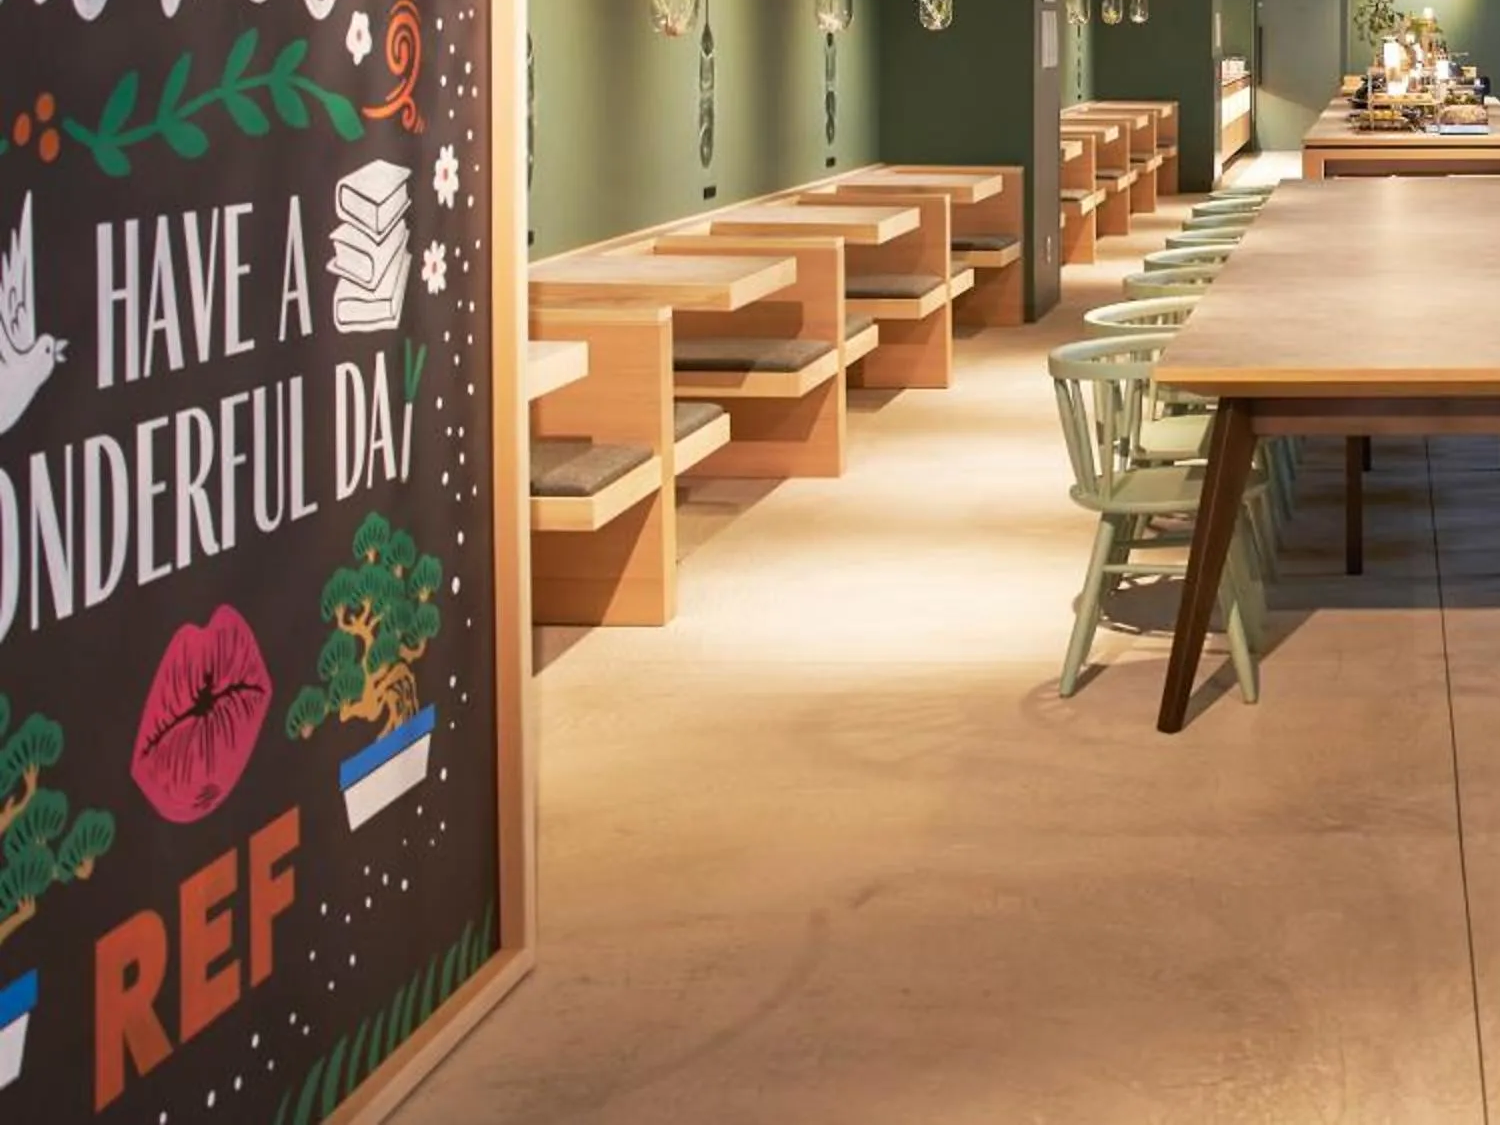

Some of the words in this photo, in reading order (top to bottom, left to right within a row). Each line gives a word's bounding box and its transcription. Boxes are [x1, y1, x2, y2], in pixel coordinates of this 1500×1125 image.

[96, 202, 254, 389] HAVE
[279, 195, 313, 342] A
[95, 804, 300, 1113] REF
